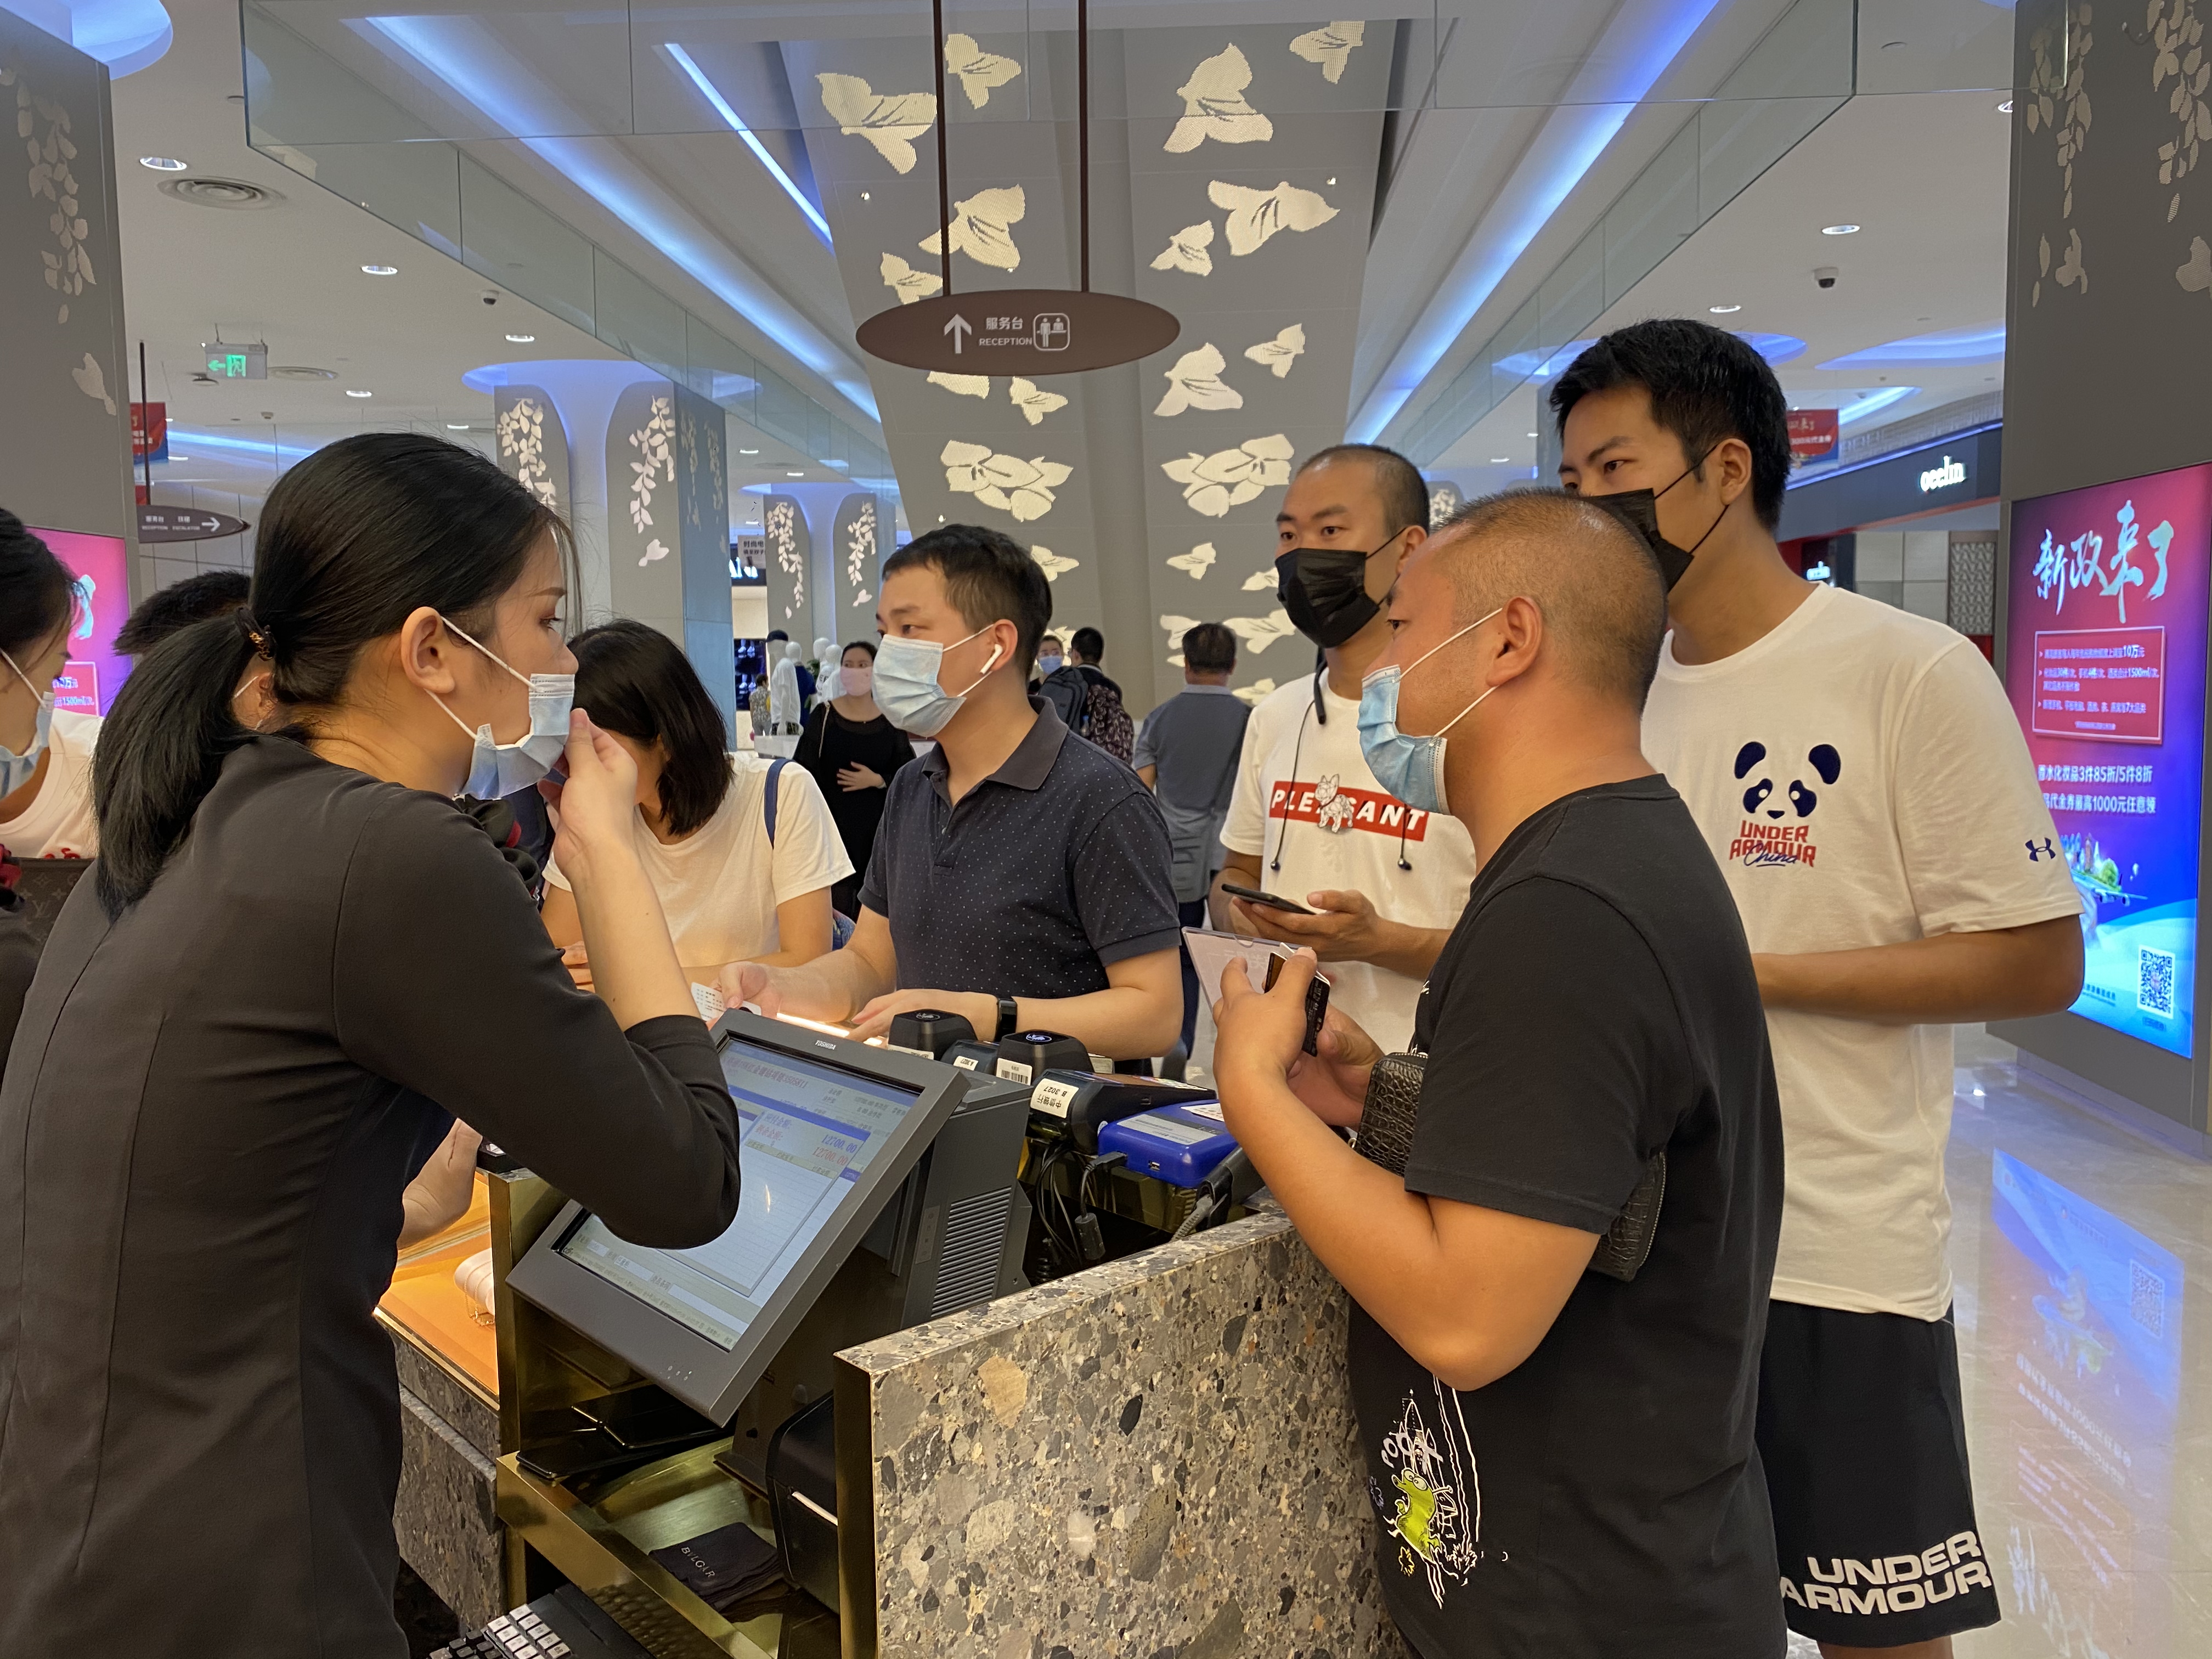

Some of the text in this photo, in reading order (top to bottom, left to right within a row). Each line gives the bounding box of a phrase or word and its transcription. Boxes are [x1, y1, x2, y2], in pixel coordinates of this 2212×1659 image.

[985, 317, 1024, 330] 服务台
[979, 337, 1032, 346] RECEPTION
[2033, 500, 2174, 624] 新政来了
[1271, 789, 1426, 831] PLEANT
[1740, 820, 1809, 843] UNDER
[1729, 839, 1816, 867] ARMOUR
[1743, 842, 1798, 867] China
[815, 1040, 837, 1051] TOSHIBA
[1043, 1085, 1061, 1095] 3027
[1037, 1094, 1062, 1109] 中信银行
[822, 1133, 859, 1154] 12700.00
[812, 1146, 849, 1166] 12700.00
[1807, 1531, 1982, 1585] UNDER
[1780, 1561, 1992, 1615] ARMOUR
